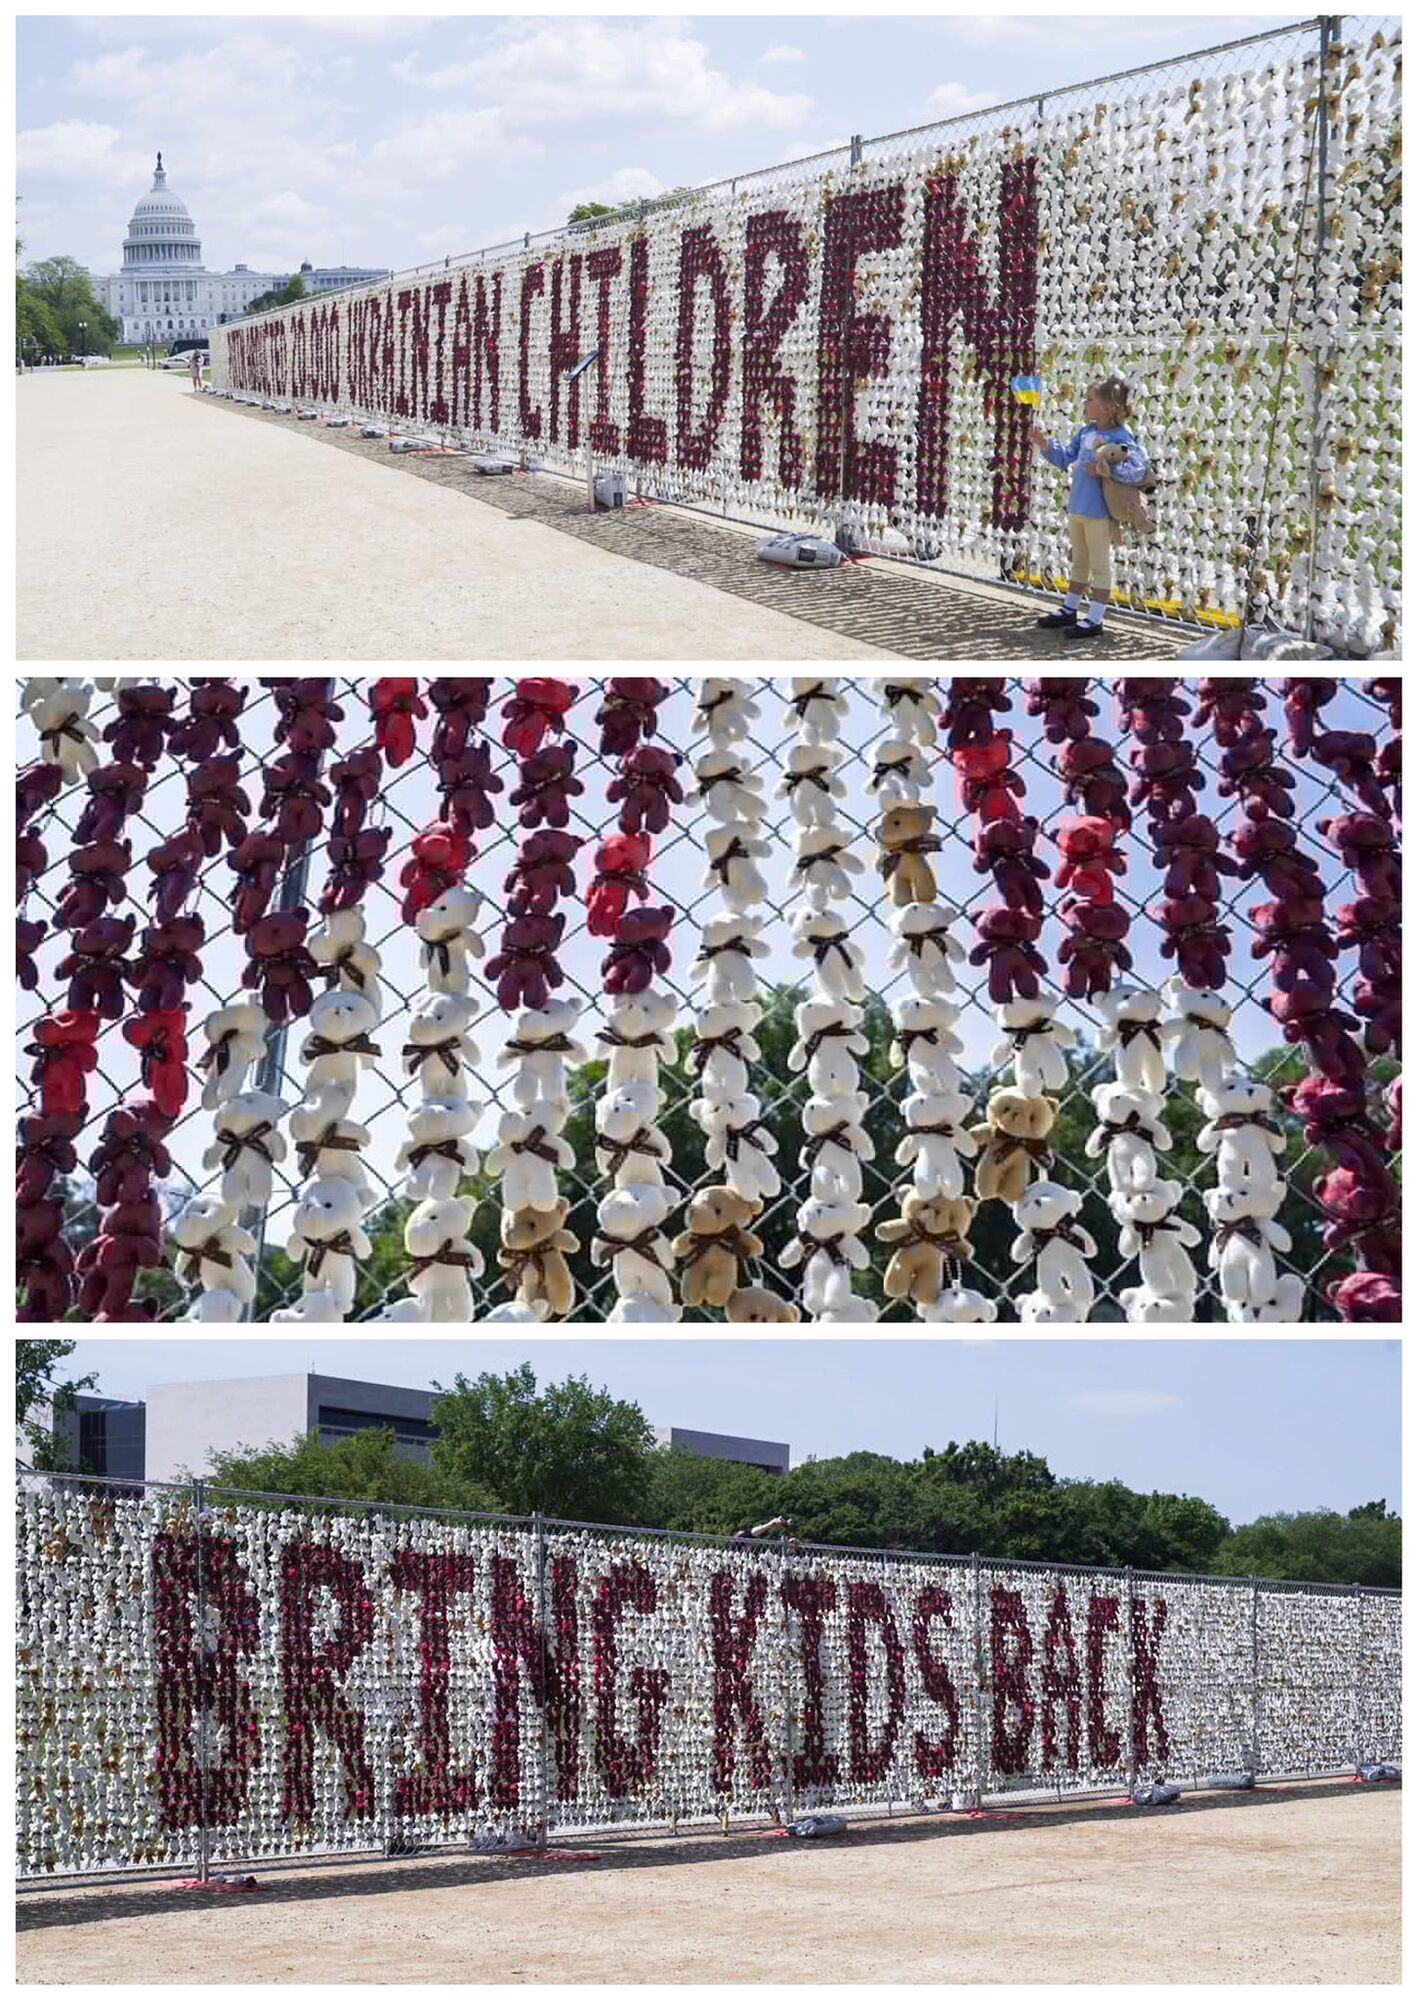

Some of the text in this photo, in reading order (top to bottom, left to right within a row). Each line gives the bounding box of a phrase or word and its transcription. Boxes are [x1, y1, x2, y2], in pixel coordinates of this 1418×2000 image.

[346, 271, 504, 434] UKRAINIAN
[517, 156, 1041, 533] CHILDREN
[152, 1531, 1170, 1832] BRING KIDS BACK
